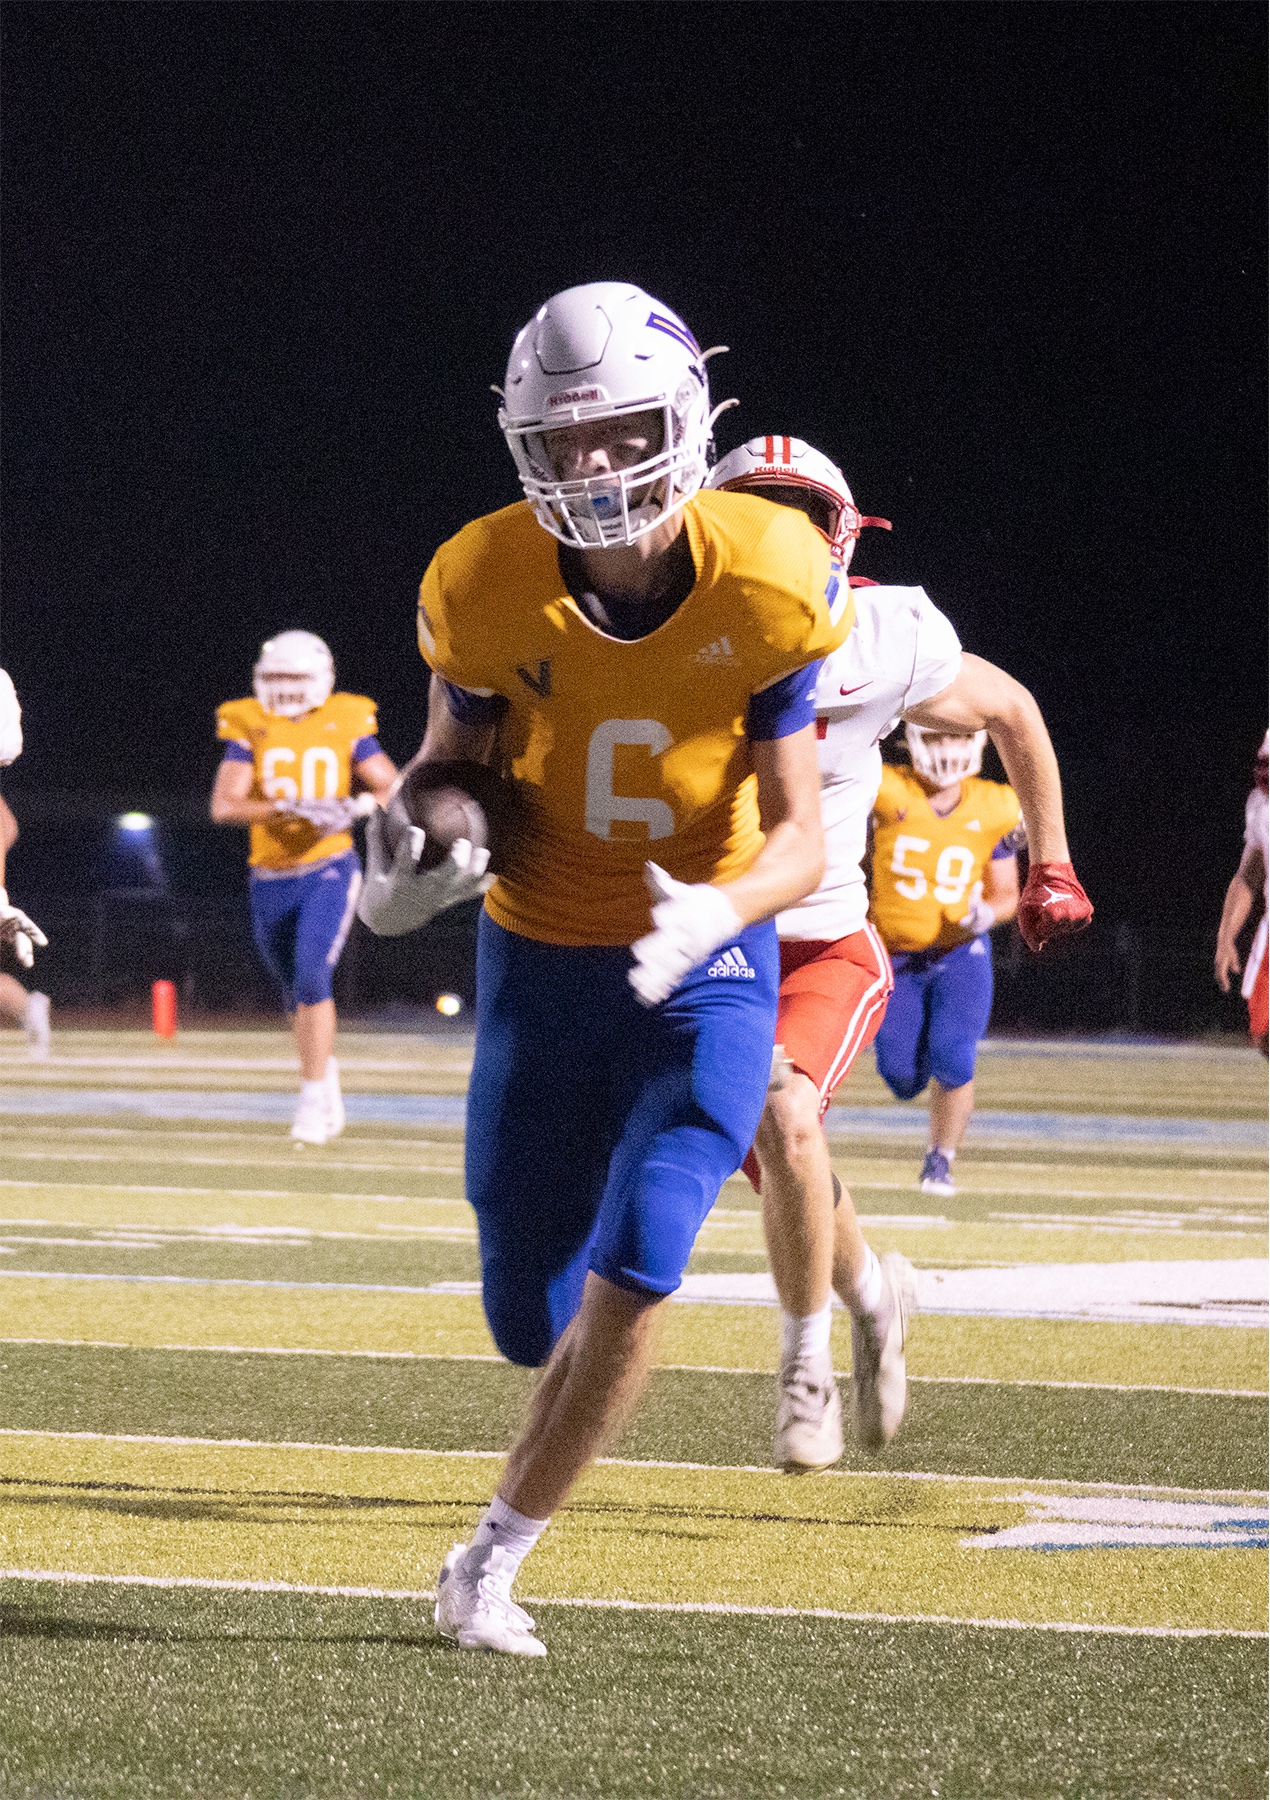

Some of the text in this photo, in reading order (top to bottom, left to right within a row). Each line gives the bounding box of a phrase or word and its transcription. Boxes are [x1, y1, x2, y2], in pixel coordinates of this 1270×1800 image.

[263, 746, 339, 801] 60
[585, 718, 675, 841] 6
[891, 834, 975, 905] 59
[707, 963, 756, 979] adidas
